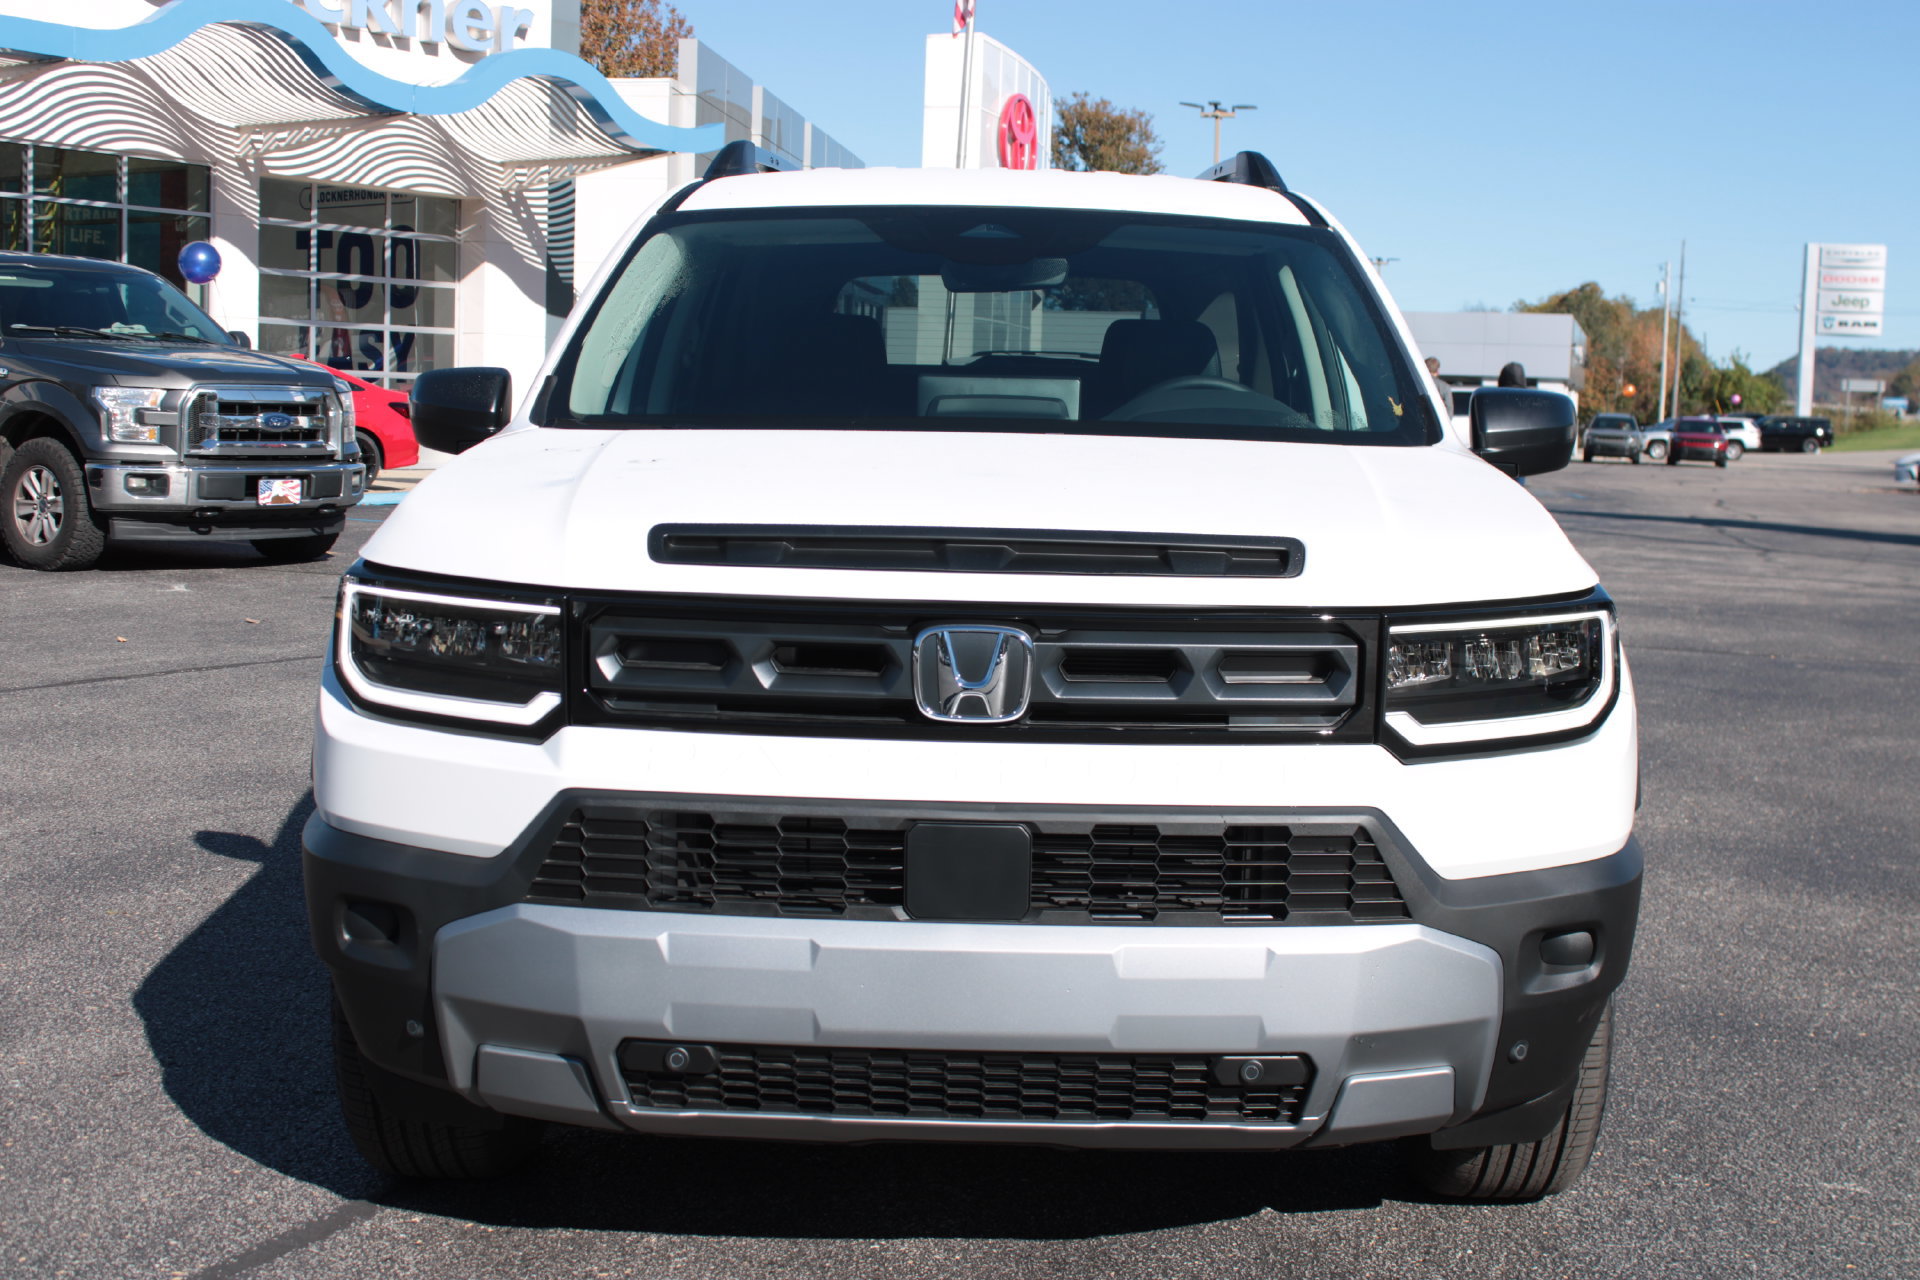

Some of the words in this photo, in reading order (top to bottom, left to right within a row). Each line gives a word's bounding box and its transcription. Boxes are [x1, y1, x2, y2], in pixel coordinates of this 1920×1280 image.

[309, 188, 409, 204] OCKNERHONDA
[70, 228, 105, 244] LIFE.
[296, 225, 420, 310] TOO
[1831, 294, 1870, 309] Jeep
[1838, 320, 1878, 328] RAM
